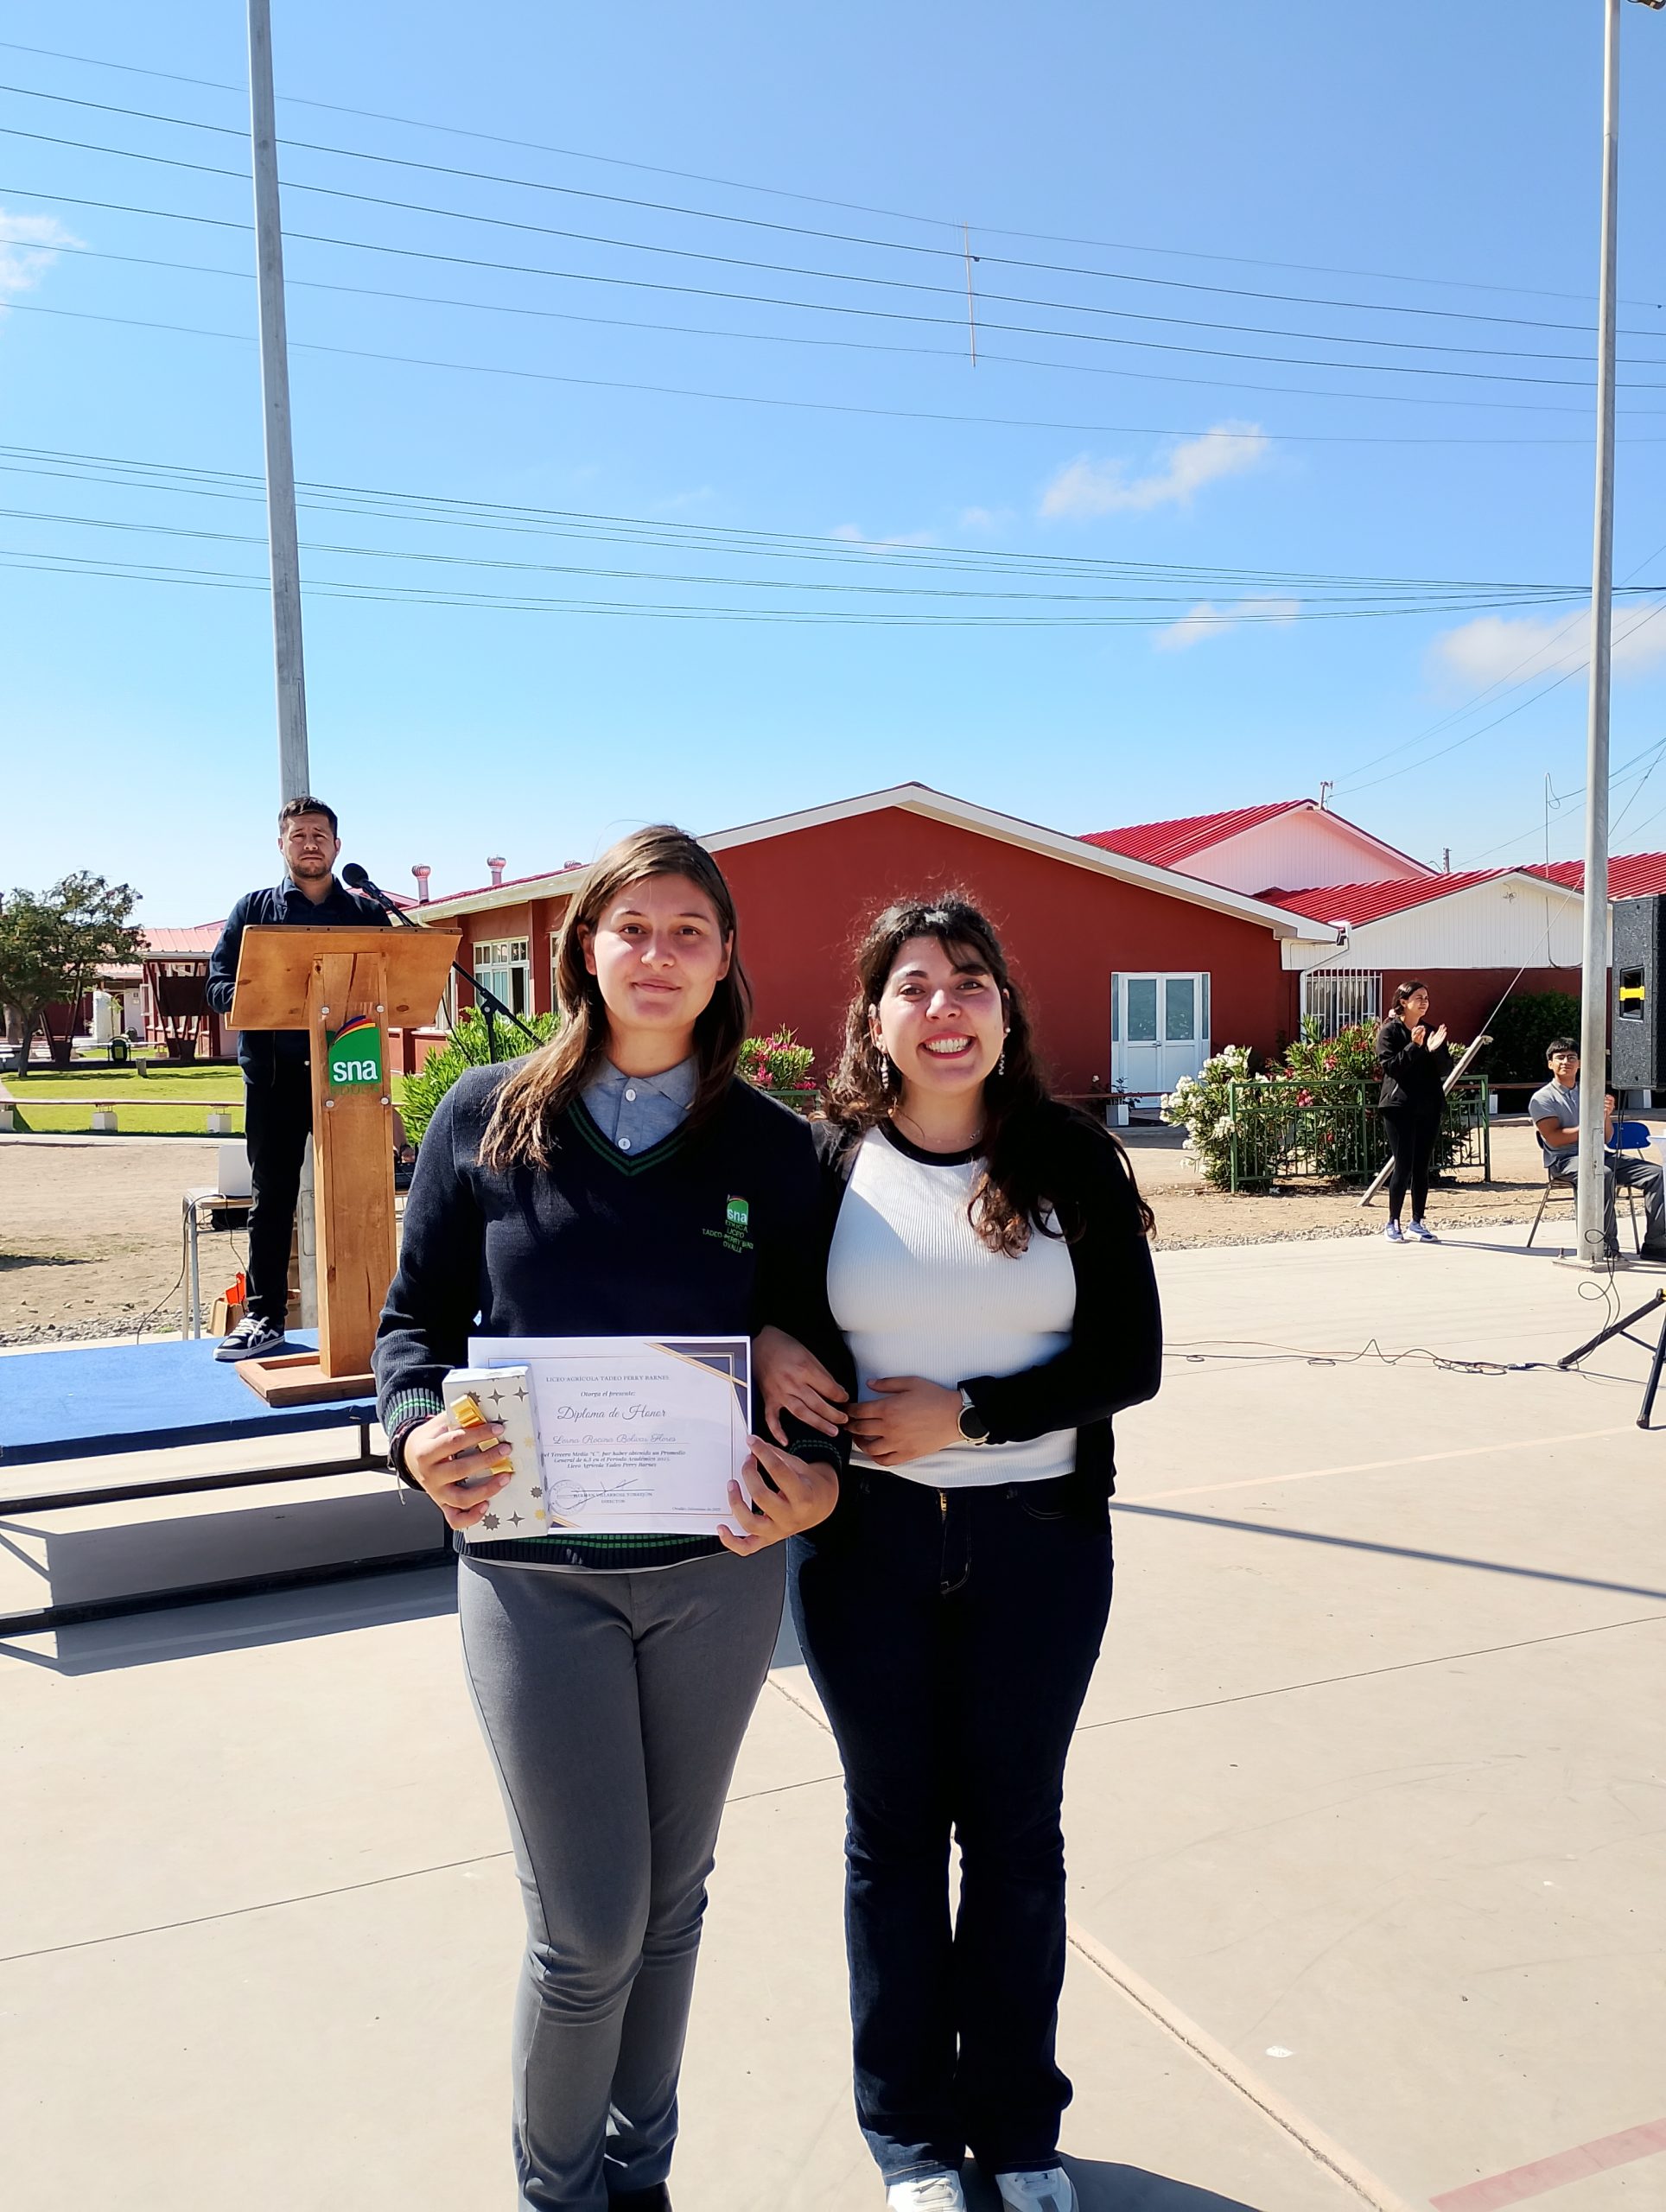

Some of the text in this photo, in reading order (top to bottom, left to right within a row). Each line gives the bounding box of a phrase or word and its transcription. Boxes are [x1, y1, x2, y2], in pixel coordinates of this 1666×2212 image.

[333, 1059, 378, 1083] sna
[727, 1209, 747, 1224] sna
[556, 1403, 666, 1423] Diploma de Honor
